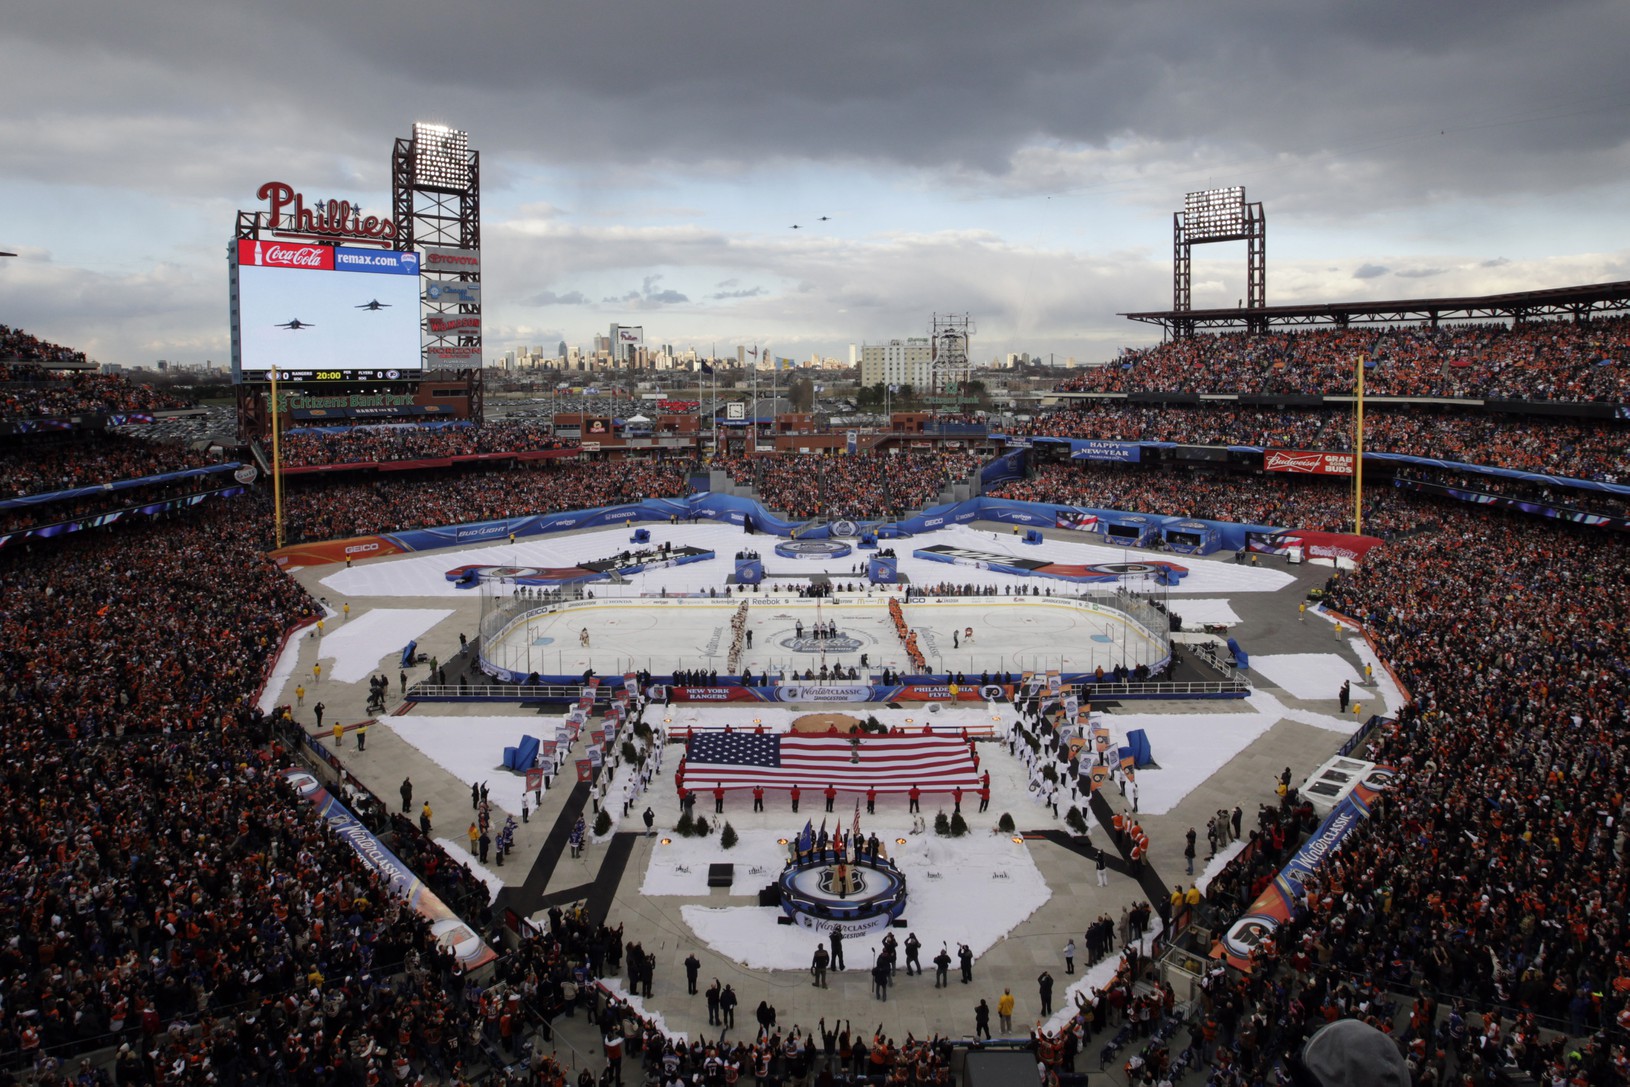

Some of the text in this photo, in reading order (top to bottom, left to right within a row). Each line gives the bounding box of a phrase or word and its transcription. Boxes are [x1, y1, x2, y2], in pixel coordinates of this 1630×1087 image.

[257, 181, 397, 239] Phillies
[265, 245, 324, 266] Coca-Cola
[337, 254, 397, 267] remax.com
[440, 255, 478, 266] TOYOTA
[282, 372, 289, 380] 0
[316, 372, 341, 380] 20:00
[290, 392, 414, 409] Citizens Bank Park
[1266, 455, 1320, 467] Budweiser
[924, 517, 944, 527] GEICO
[1011, 513, 1032, 521] verizon
[458, 526, 507, 537] BUD LIGHT
[345, 543, 379, 554] GEICO
[525, 607, 548, 619] GEICO
